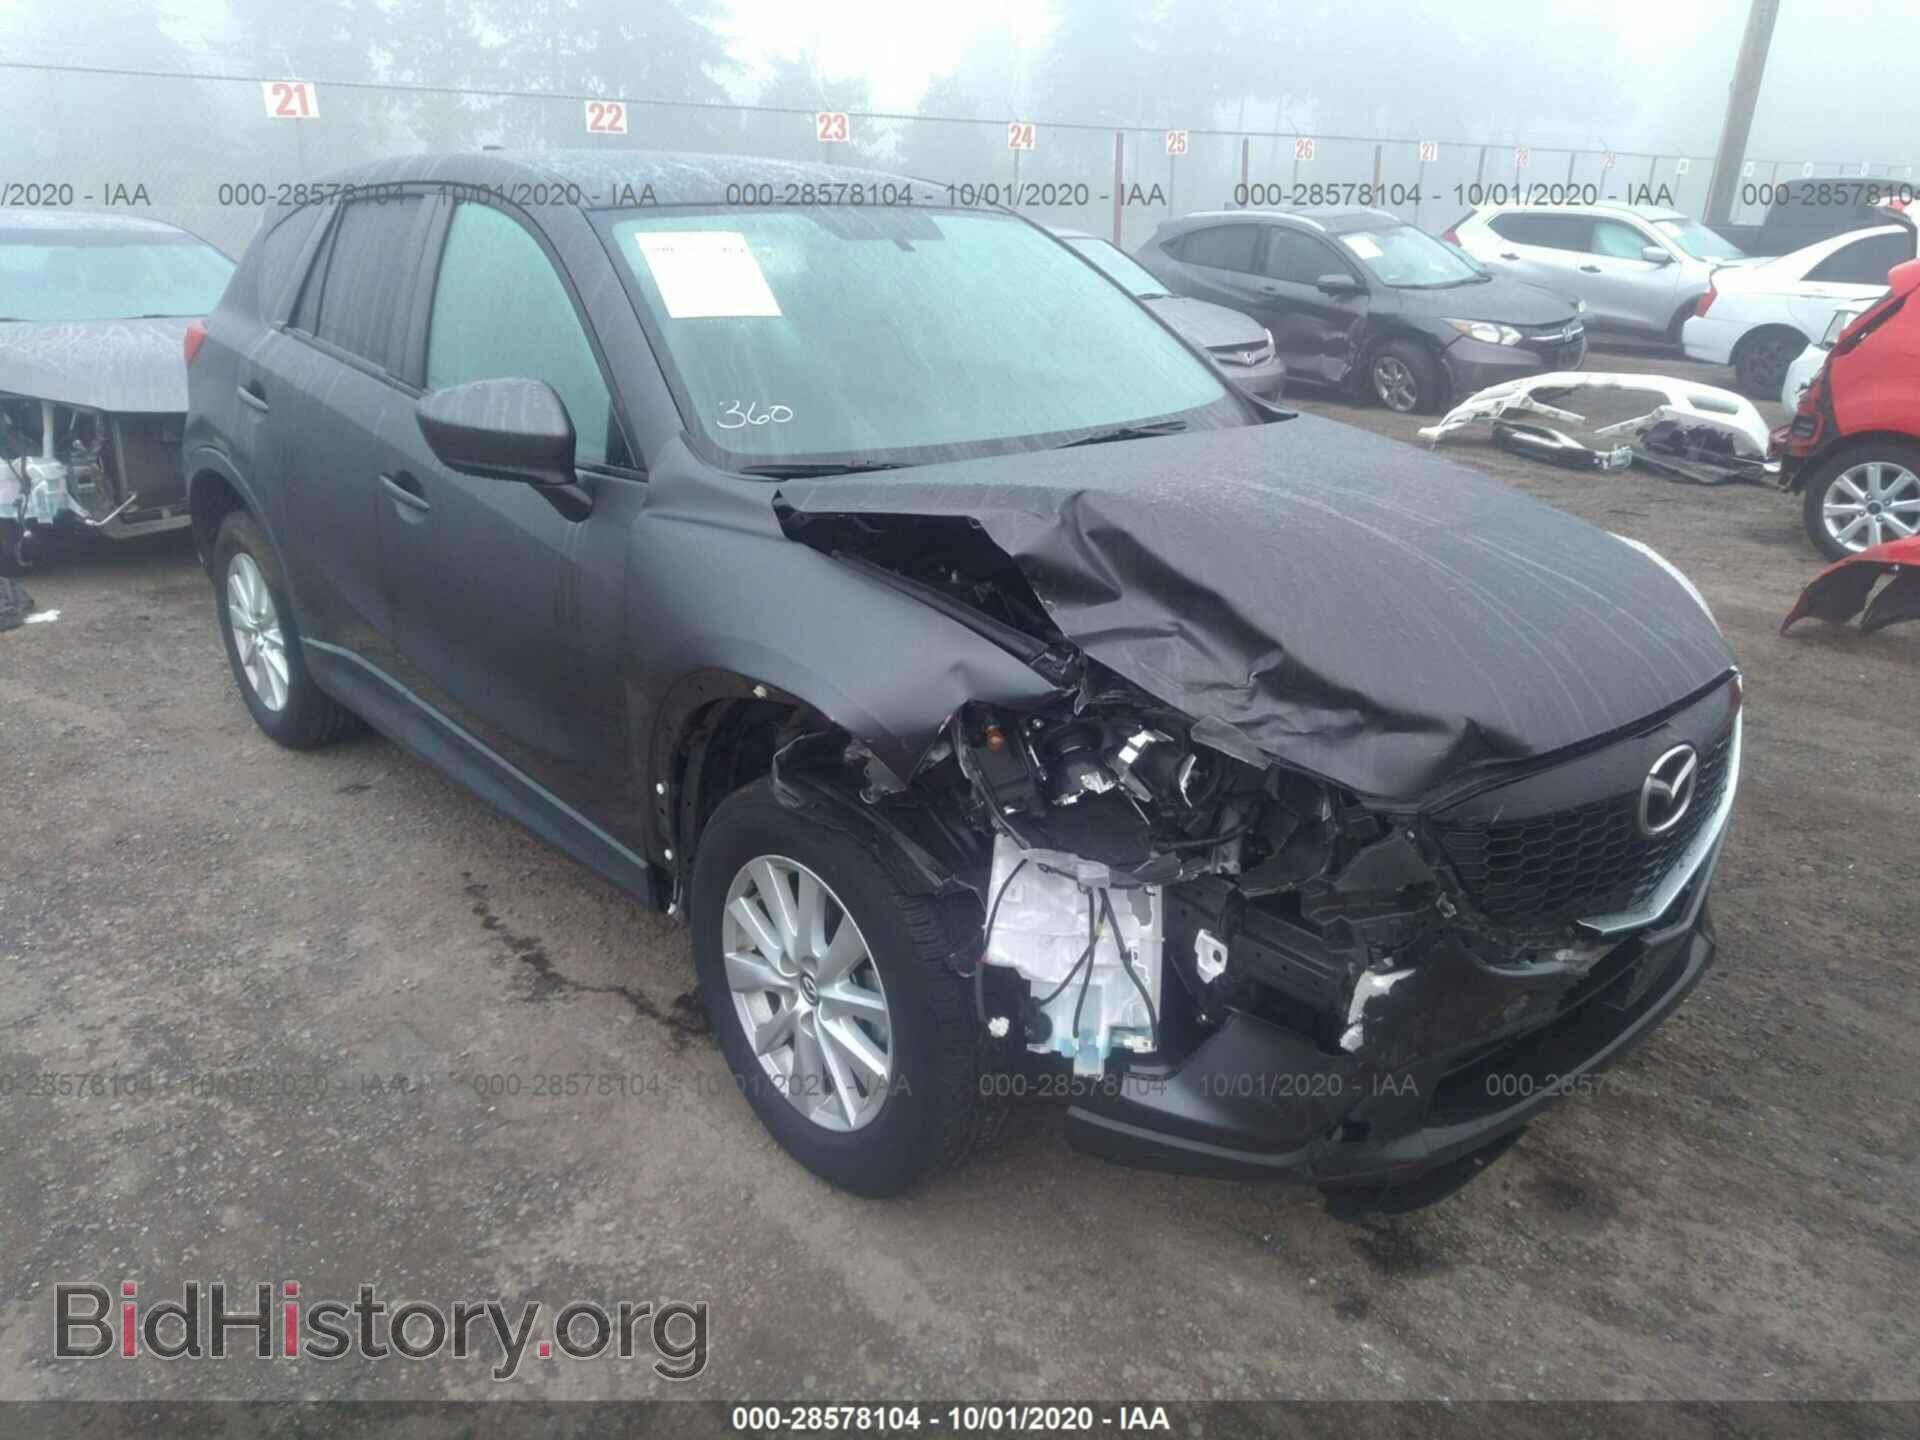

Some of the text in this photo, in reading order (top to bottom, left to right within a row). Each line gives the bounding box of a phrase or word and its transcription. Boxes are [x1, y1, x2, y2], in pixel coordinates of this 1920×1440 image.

[272, 83, 310, 115] 21
[589, 103, 624, 131] 22
[819, 114, 847, 139] 23
[1010, 125, 1033, 148] 24
[1168, 132, 1185, 152] 25
[1296, 139, 1313, 159] 26
[716, 400, 793, 429] 360
